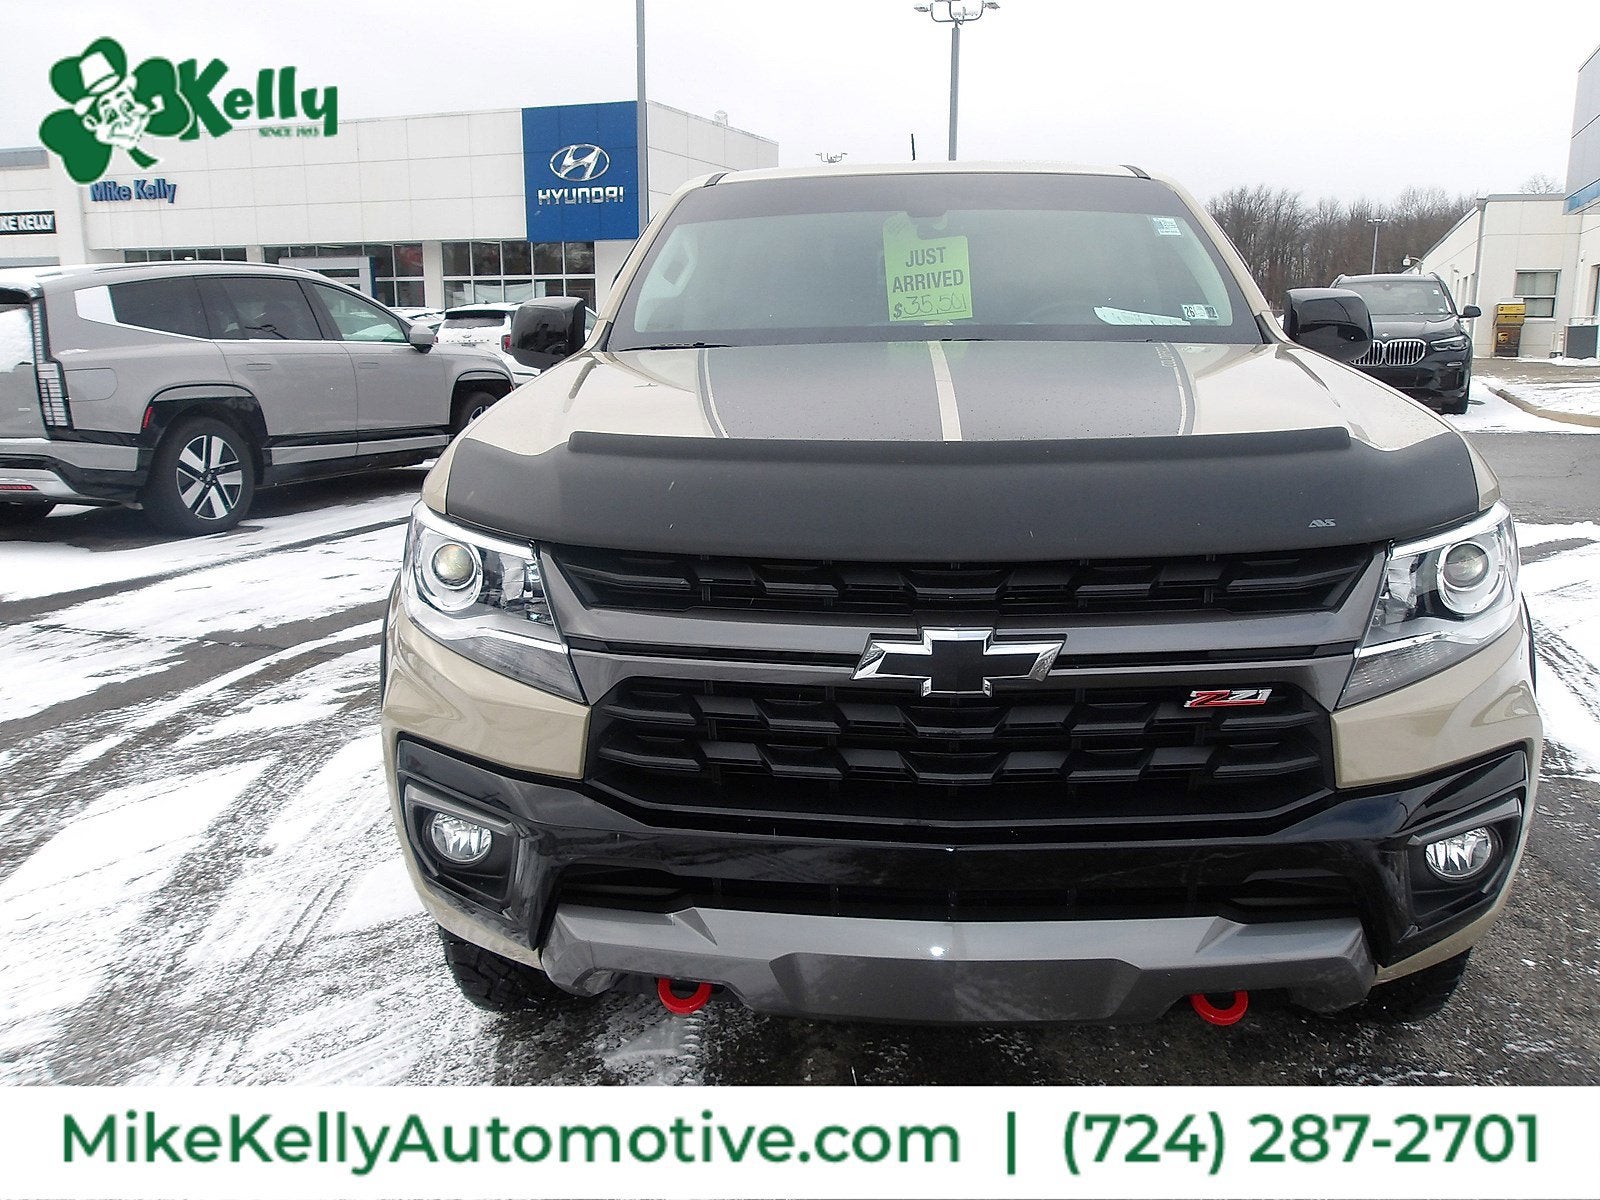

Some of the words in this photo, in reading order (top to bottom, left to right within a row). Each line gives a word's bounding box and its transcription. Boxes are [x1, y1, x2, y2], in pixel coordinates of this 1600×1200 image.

[91, 181, 131, 201] Mike
[133, 178, 176, 203] Kelly
[538, 186, 624, 205] HYUNDAI
[18, 214, 52, 230] KELLY
[905, 246, 946, 267] JUST
[893, 269, 964, 293] ARRIVED
[1184, 688, 1273, 708] Z71
